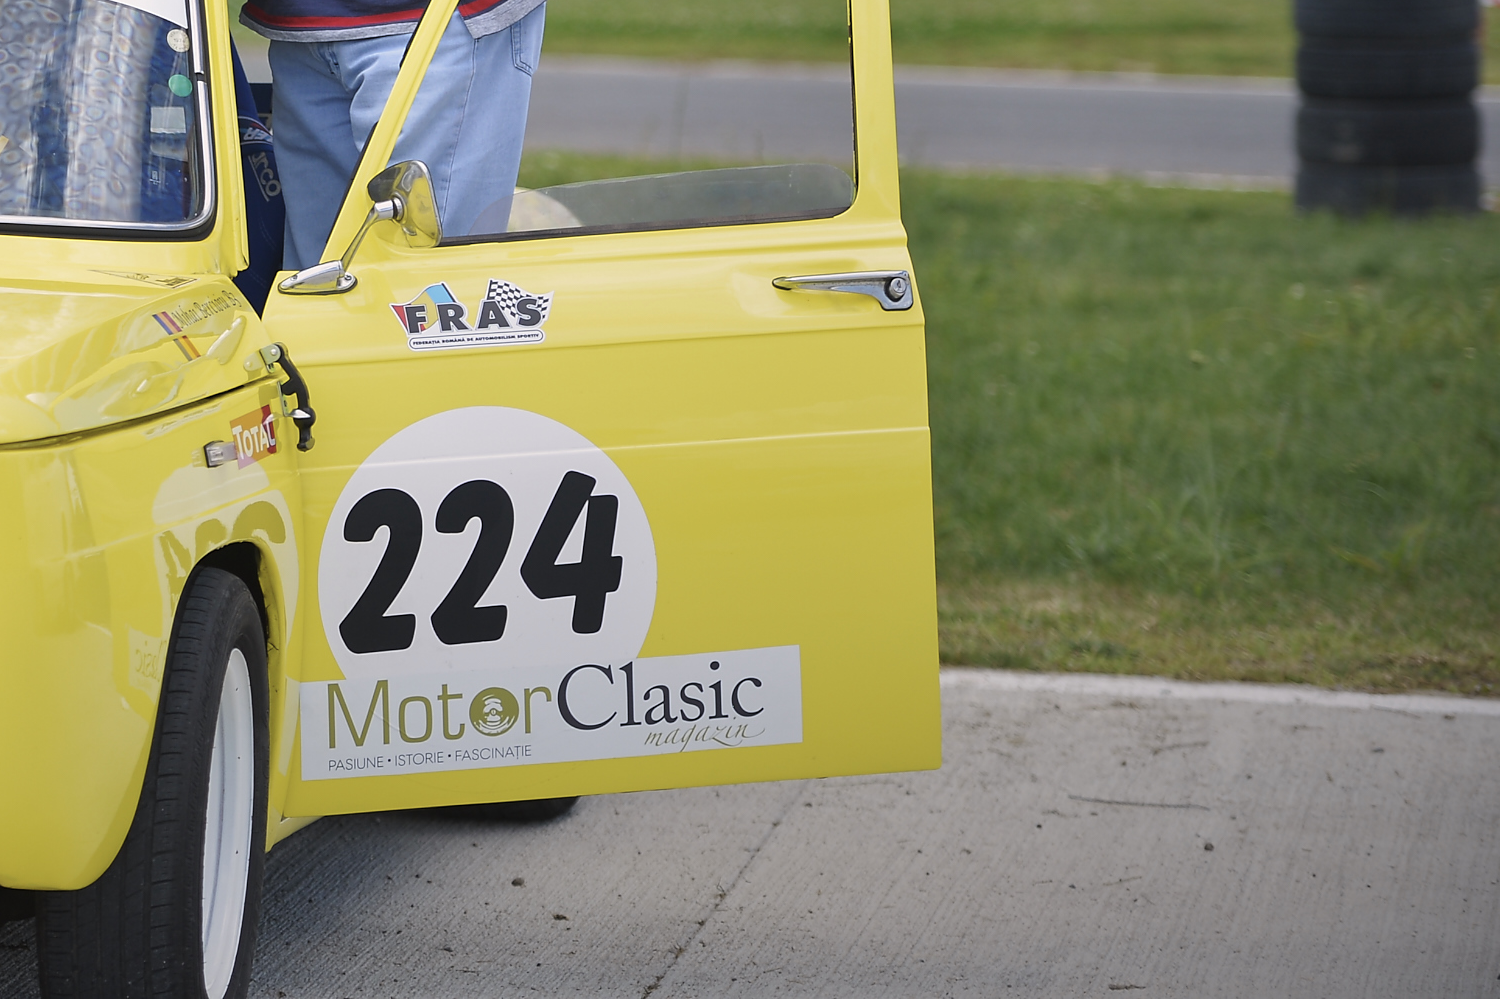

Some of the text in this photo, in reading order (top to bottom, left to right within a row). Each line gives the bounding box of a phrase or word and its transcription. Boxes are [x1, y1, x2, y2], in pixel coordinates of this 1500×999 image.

[404, 297, 542, 334] FRAS
[338, 470, 624, 654] 224
[644, 716, 766, 753] magazin
[328, 755, 385, 772] PASIUNE
[394, 750, 445, 767] ISTORIE
